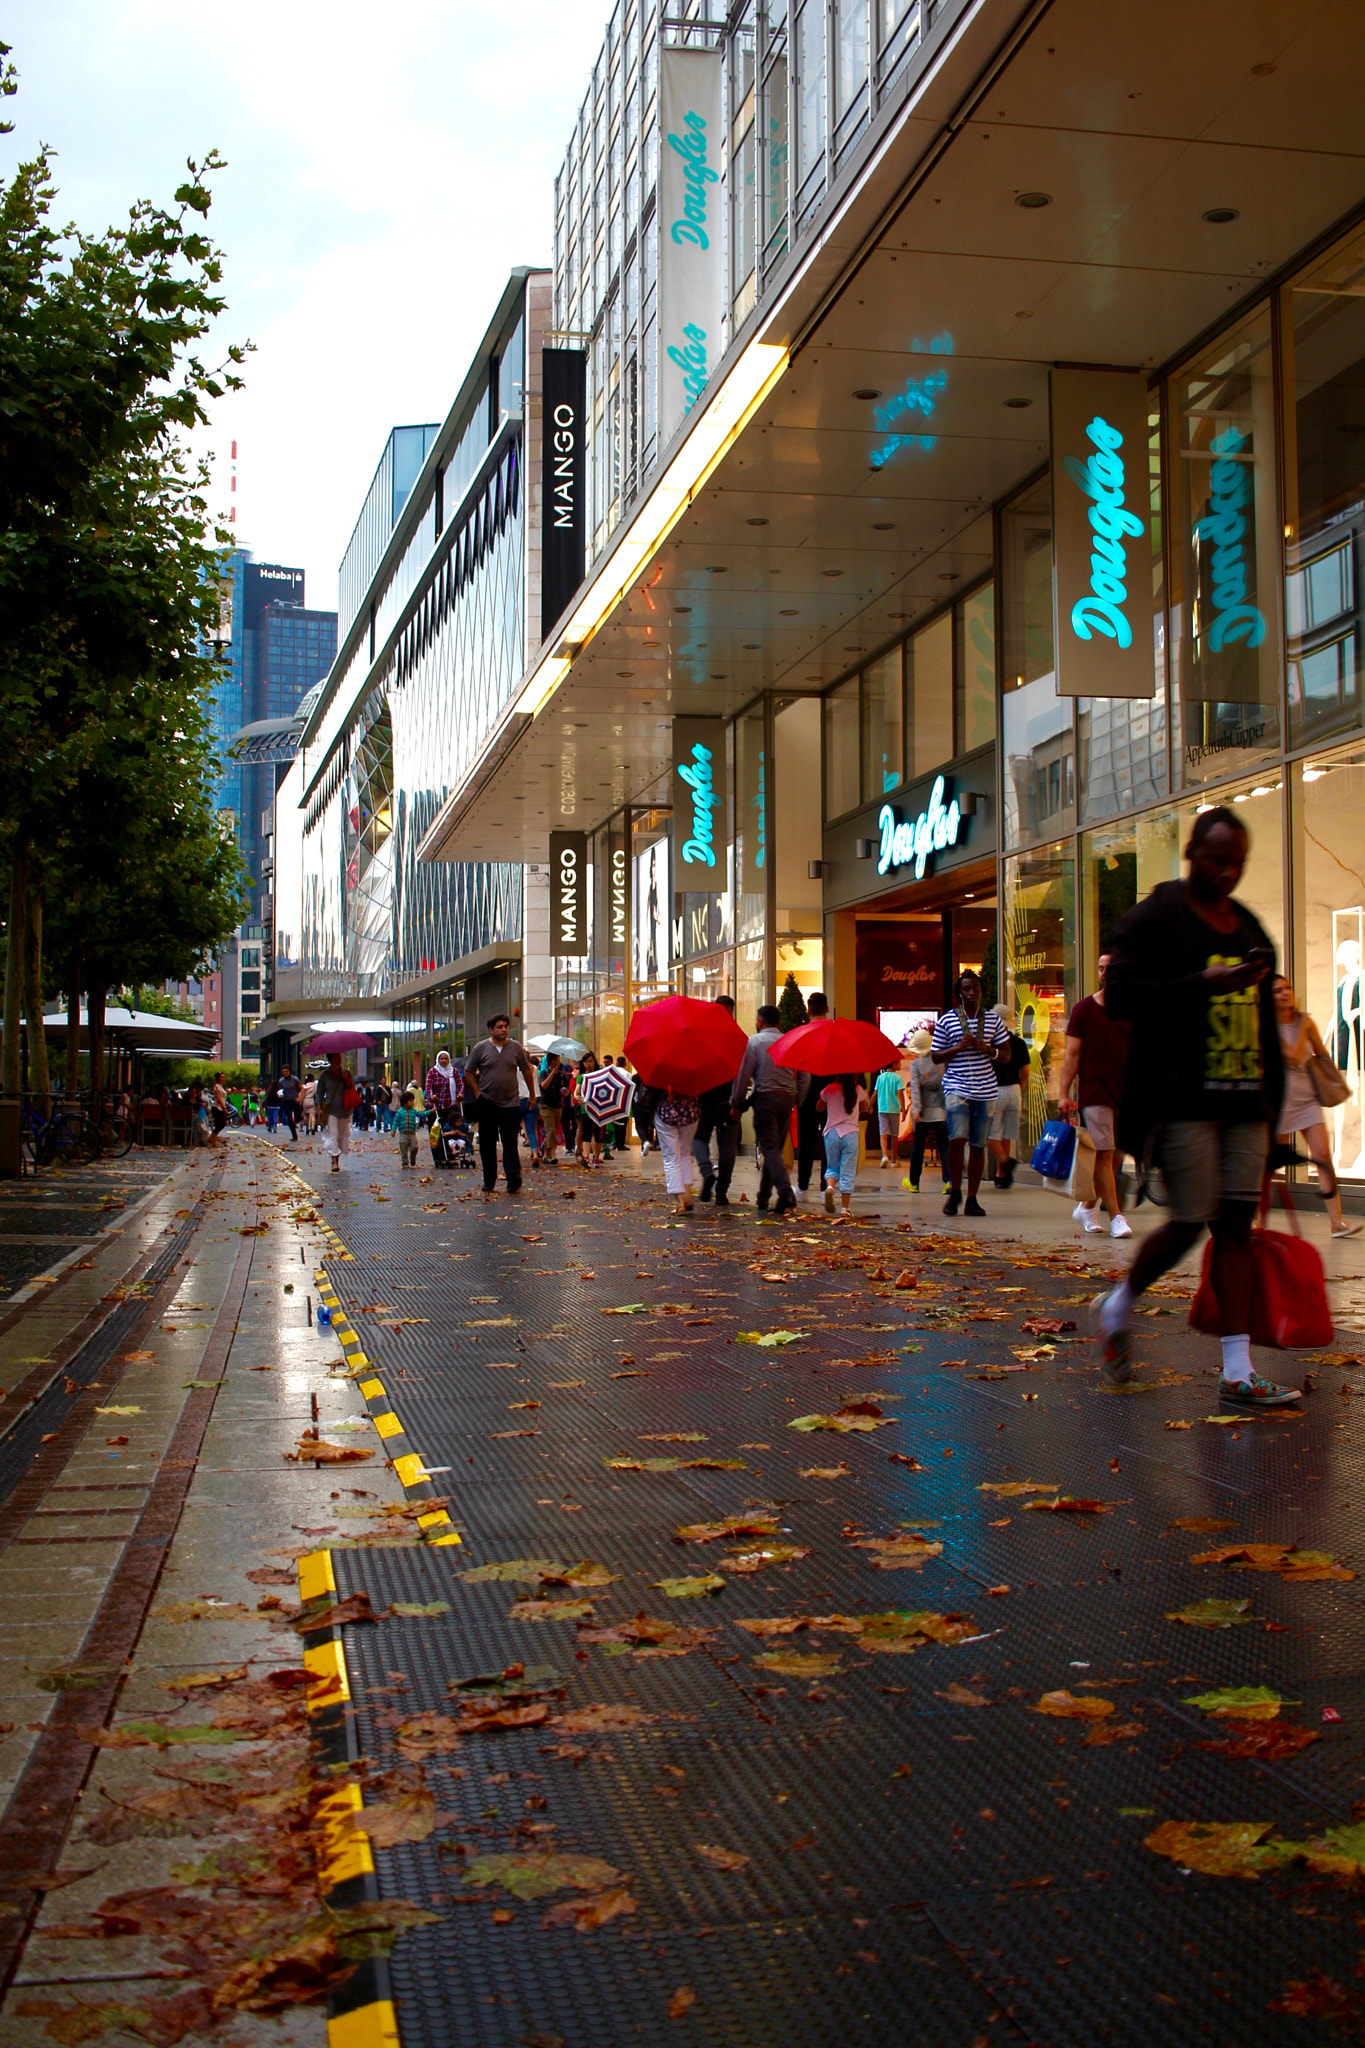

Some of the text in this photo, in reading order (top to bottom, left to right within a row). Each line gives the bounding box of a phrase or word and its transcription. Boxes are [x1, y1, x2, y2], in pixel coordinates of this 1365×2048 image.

[667, 110, 719, 250] Douglas
[554, 404, 574, 528] MANGO
[260, 568, 292, 580] Helaba
[1062, 416, 1145, 649] Douglas
[677, 742, 722, 867] Douglas
[877, 774, 960, 879] Douglas
[561, 849, 577, 942] MANGO
[881, 964, 937, 986] Douglas
